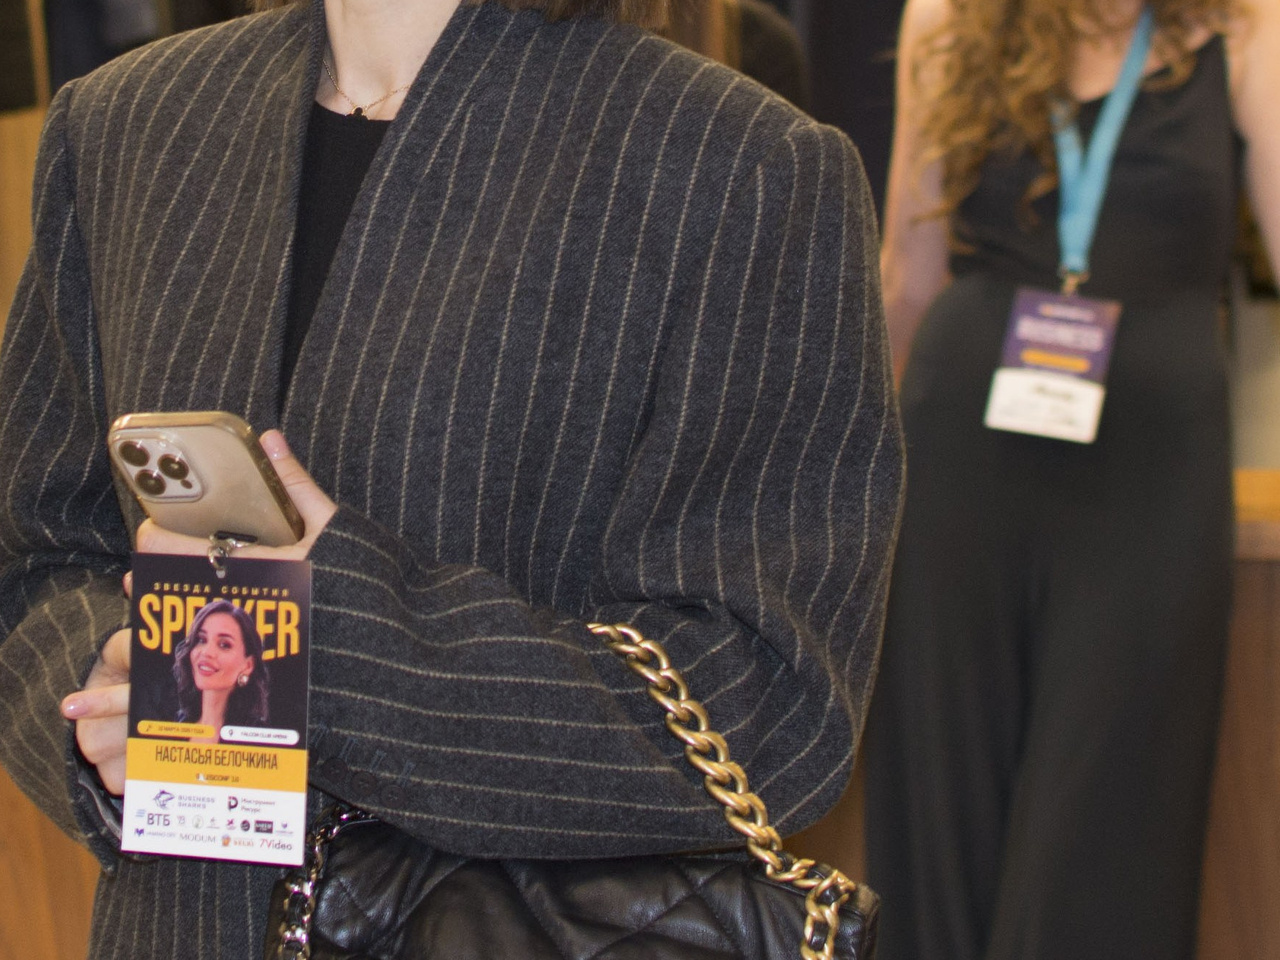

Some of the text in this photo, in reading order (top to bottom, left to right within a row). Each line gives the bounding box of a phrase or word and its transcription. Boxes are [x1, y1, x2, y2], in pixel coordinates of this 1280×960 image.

[154, 582, 289, 596] ЗВЕЗДА СОБЫТИЯ
[139, 593, 301, 661] SPEER
[155, 745, 278, 769] НАСТАСЬЯ БЕЛОЧКИНА
[178, 795, 215, 803] BUSINESS
[147, 813, 170, 826] ВТБ
[179, 833, 216, 843] MODUM
[260, 838, 292, 850] 7Video
